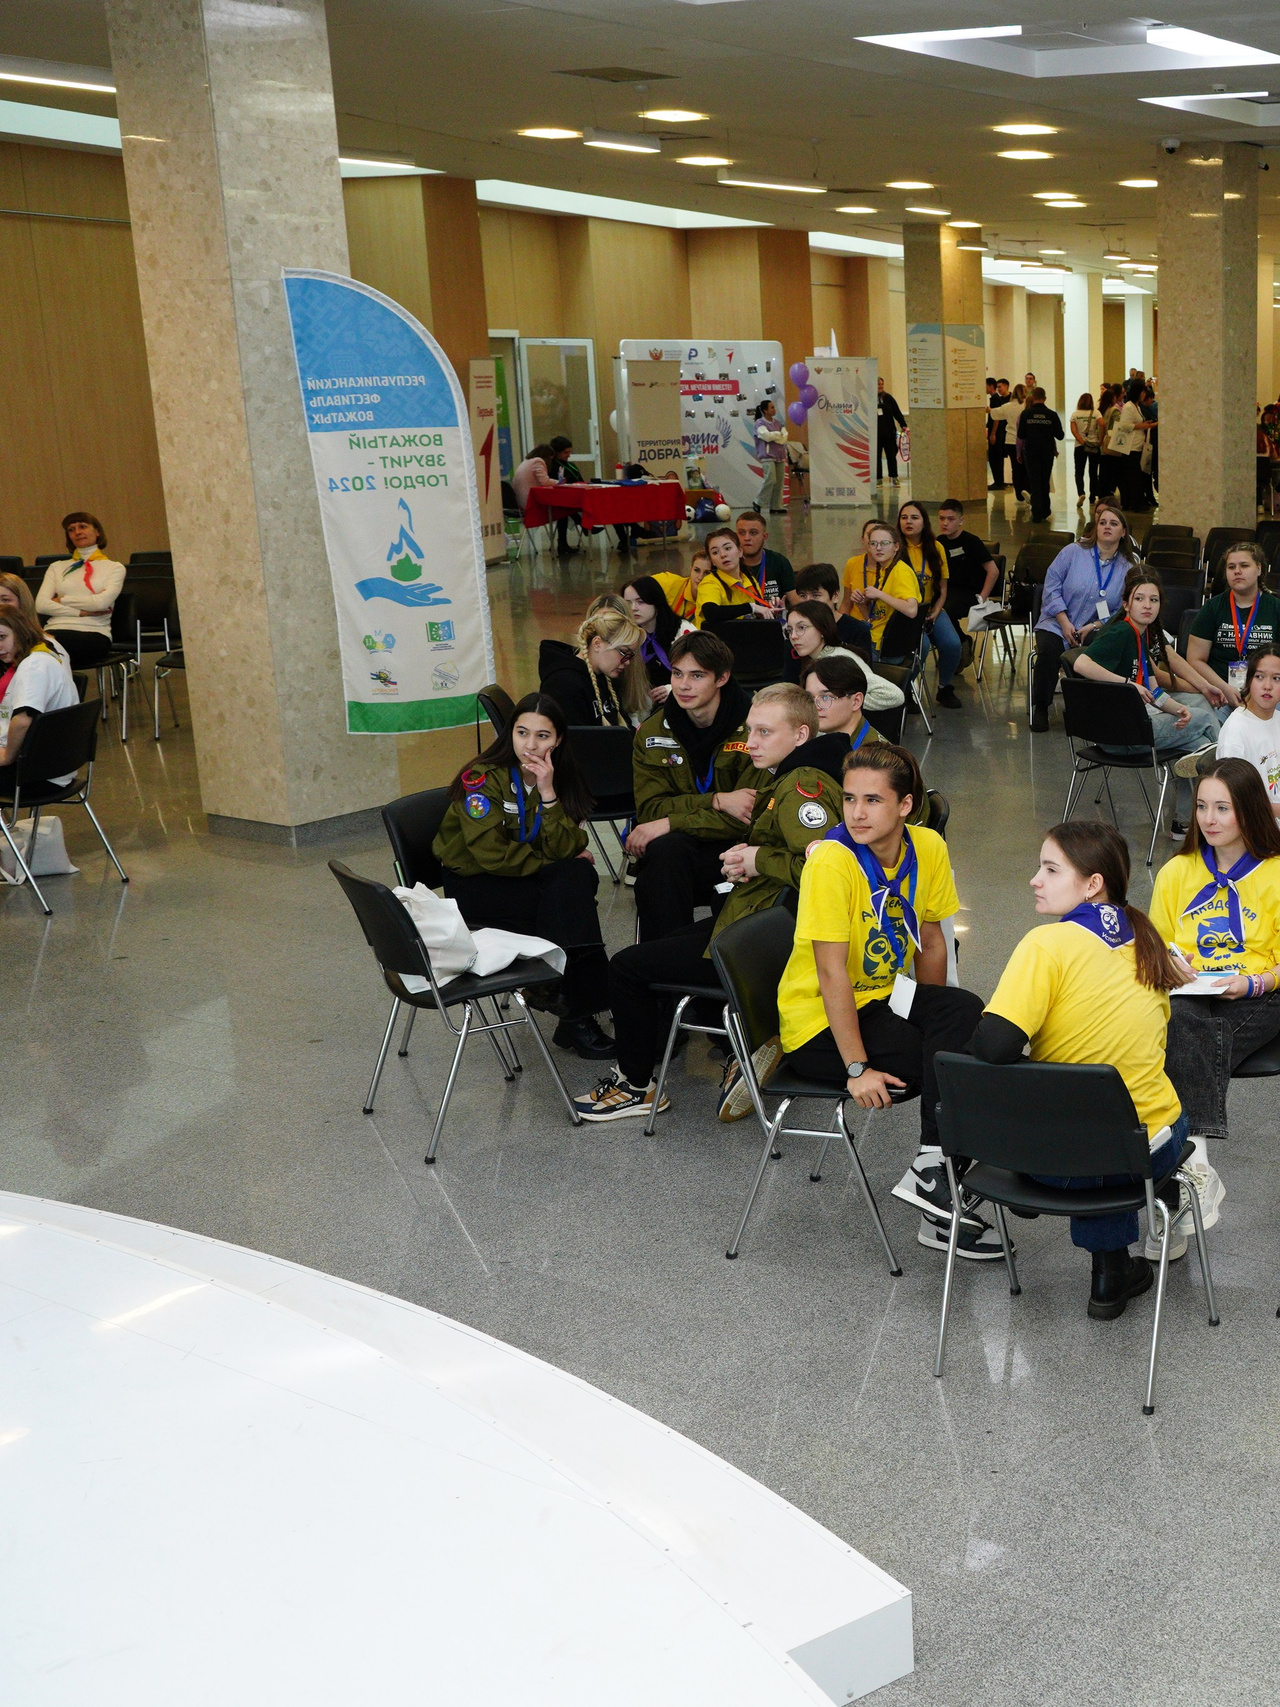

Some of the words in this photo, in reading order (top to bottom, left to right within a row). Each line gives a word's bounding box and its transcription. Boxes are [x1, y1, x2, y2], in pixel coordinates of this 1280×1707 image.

[637, 439, 680, 447] ТЕРРИТОРИЯ
[638, 448, 681, 463] ДОБРА
[616, 1101, 633, 1109] adidas
